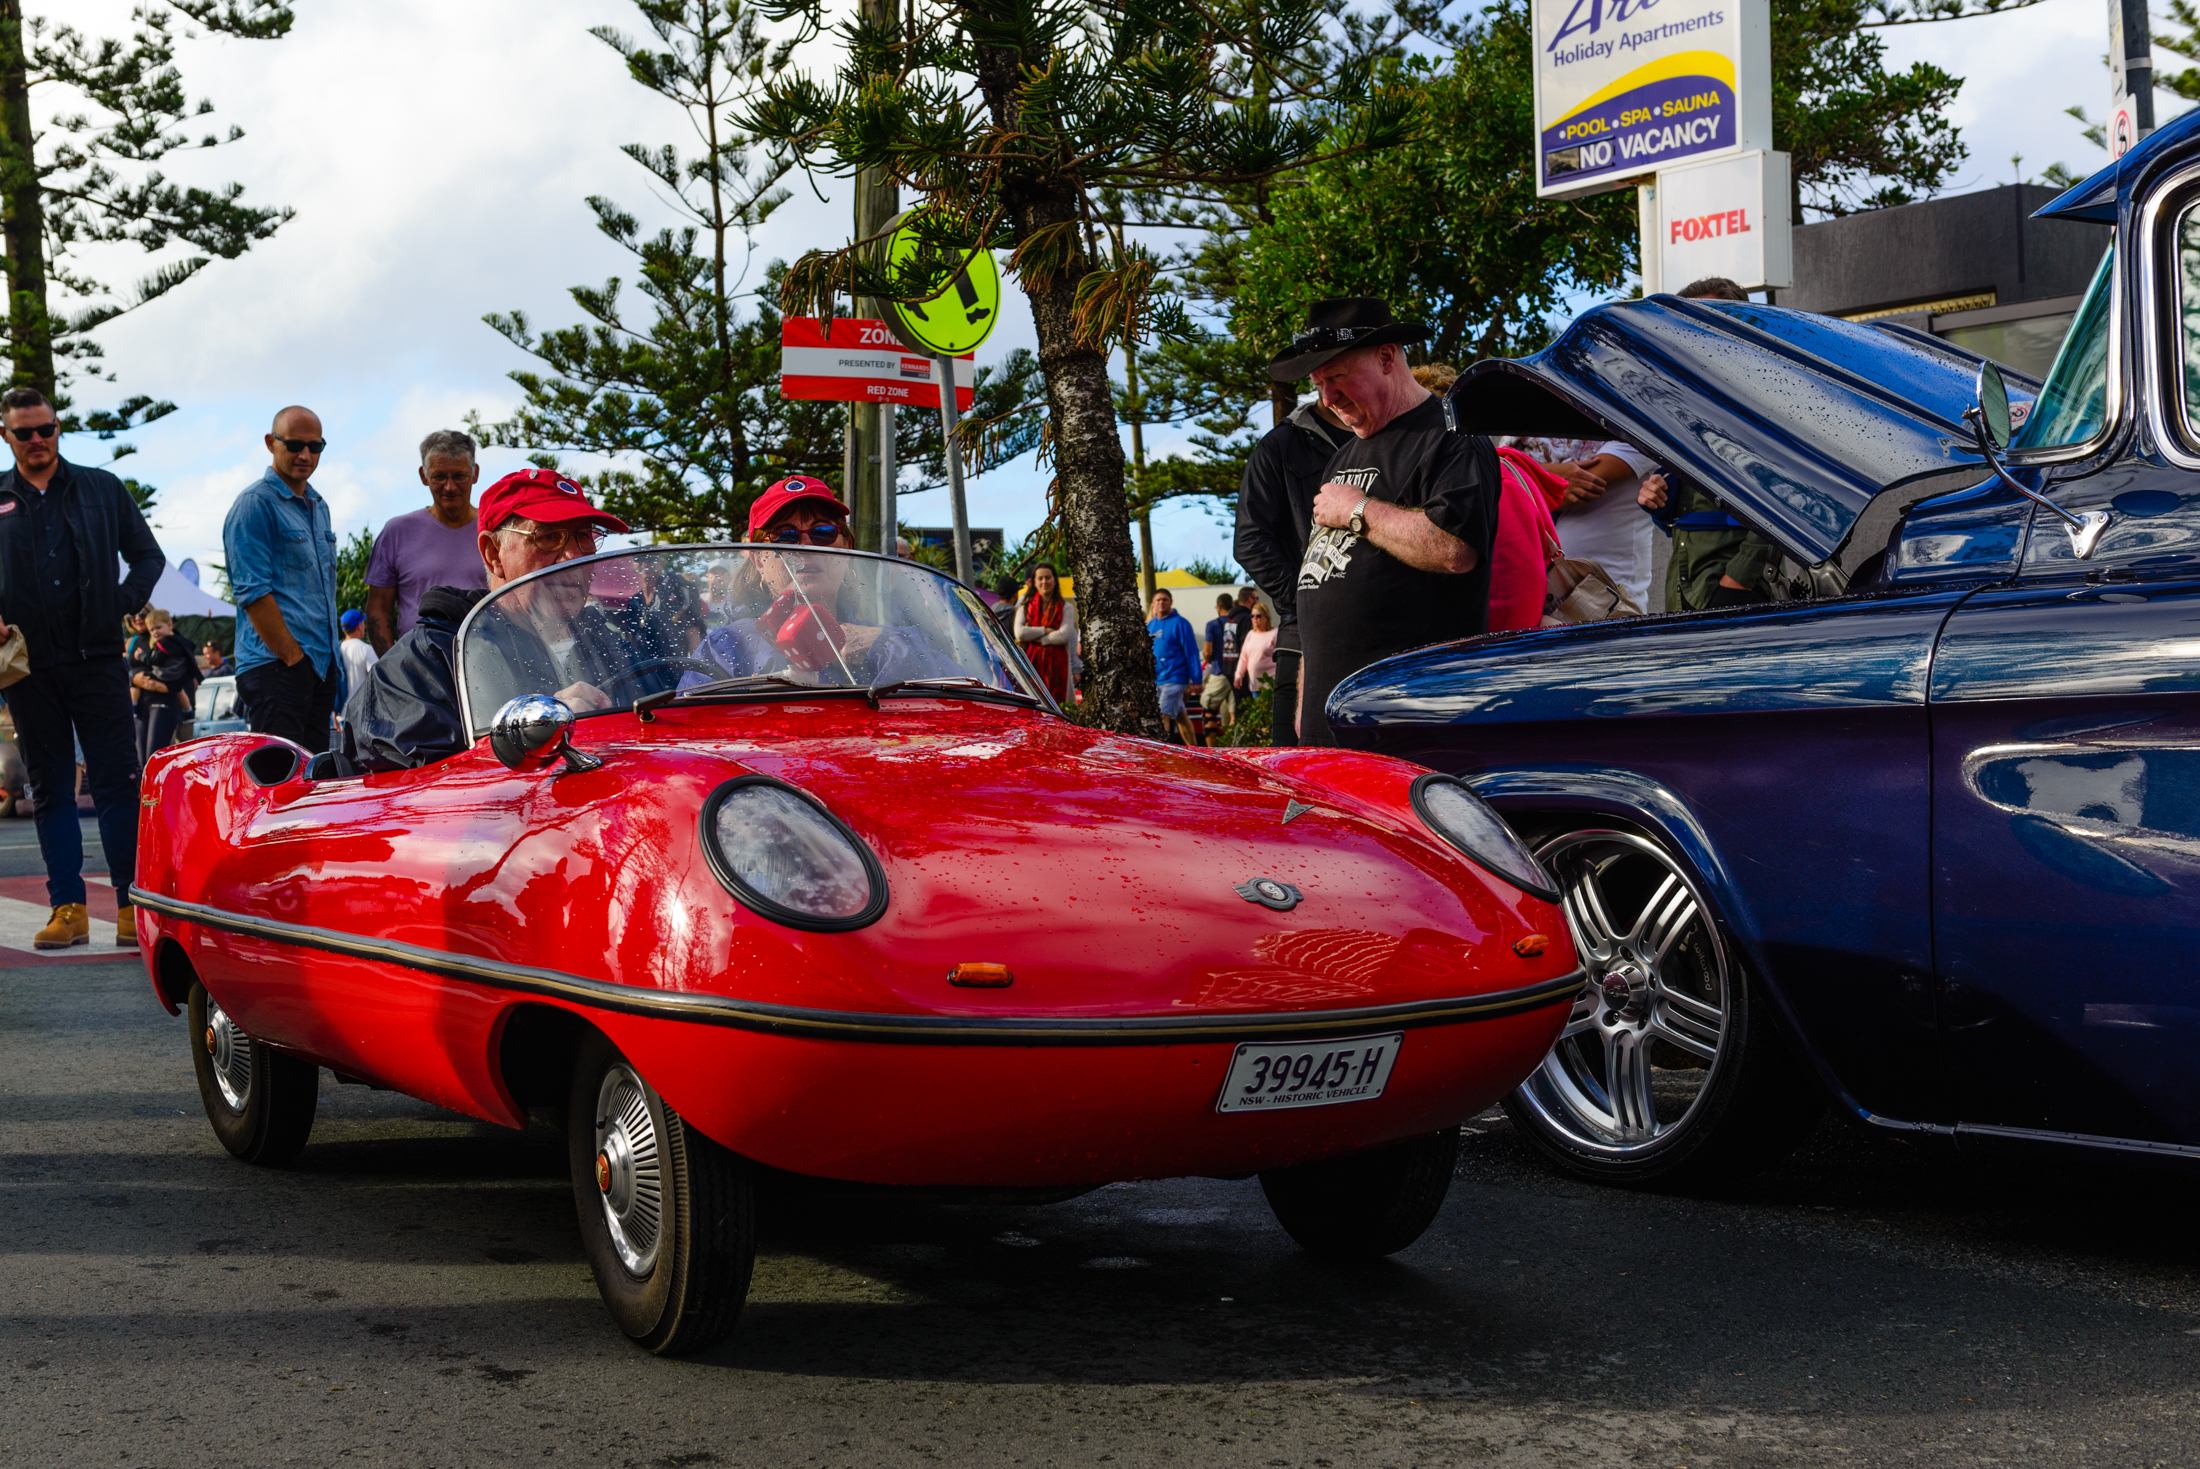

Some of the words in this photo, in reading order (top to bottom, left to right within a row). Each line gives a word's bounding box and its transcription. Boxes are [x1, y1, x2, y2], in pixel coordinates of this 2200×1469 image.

[1554, 40, 1615, 67] Holiday
[1619, 11, 1724, 51] Apartments
[1567, 118, 1610, 140] POOL
[1620, 107, 1652, 128] SPA
[1662, 91, 1720, 117] SAUNA
[1580, 141, 1612, 169] NO
[1619, 115, 1721, 160] VACANCY
[1671, 209, 1751, 245] FOXTEL
[860, 327, 903, 346] ZON
[838, 359, 885, 368] PRESENTED
[901, 363, 930, 371] KENNARDS
[867, 385, 886, 396] RED
[887, 387, 909, 398] ZONE
[1693, 942, 1713, 991] wilwood
[1238, 1096, 1265, 1106] NSW
[1273, 1091, 1323, 1104] HISTORIC
[1326, 1085, 1368, 1099] VEHICLE
